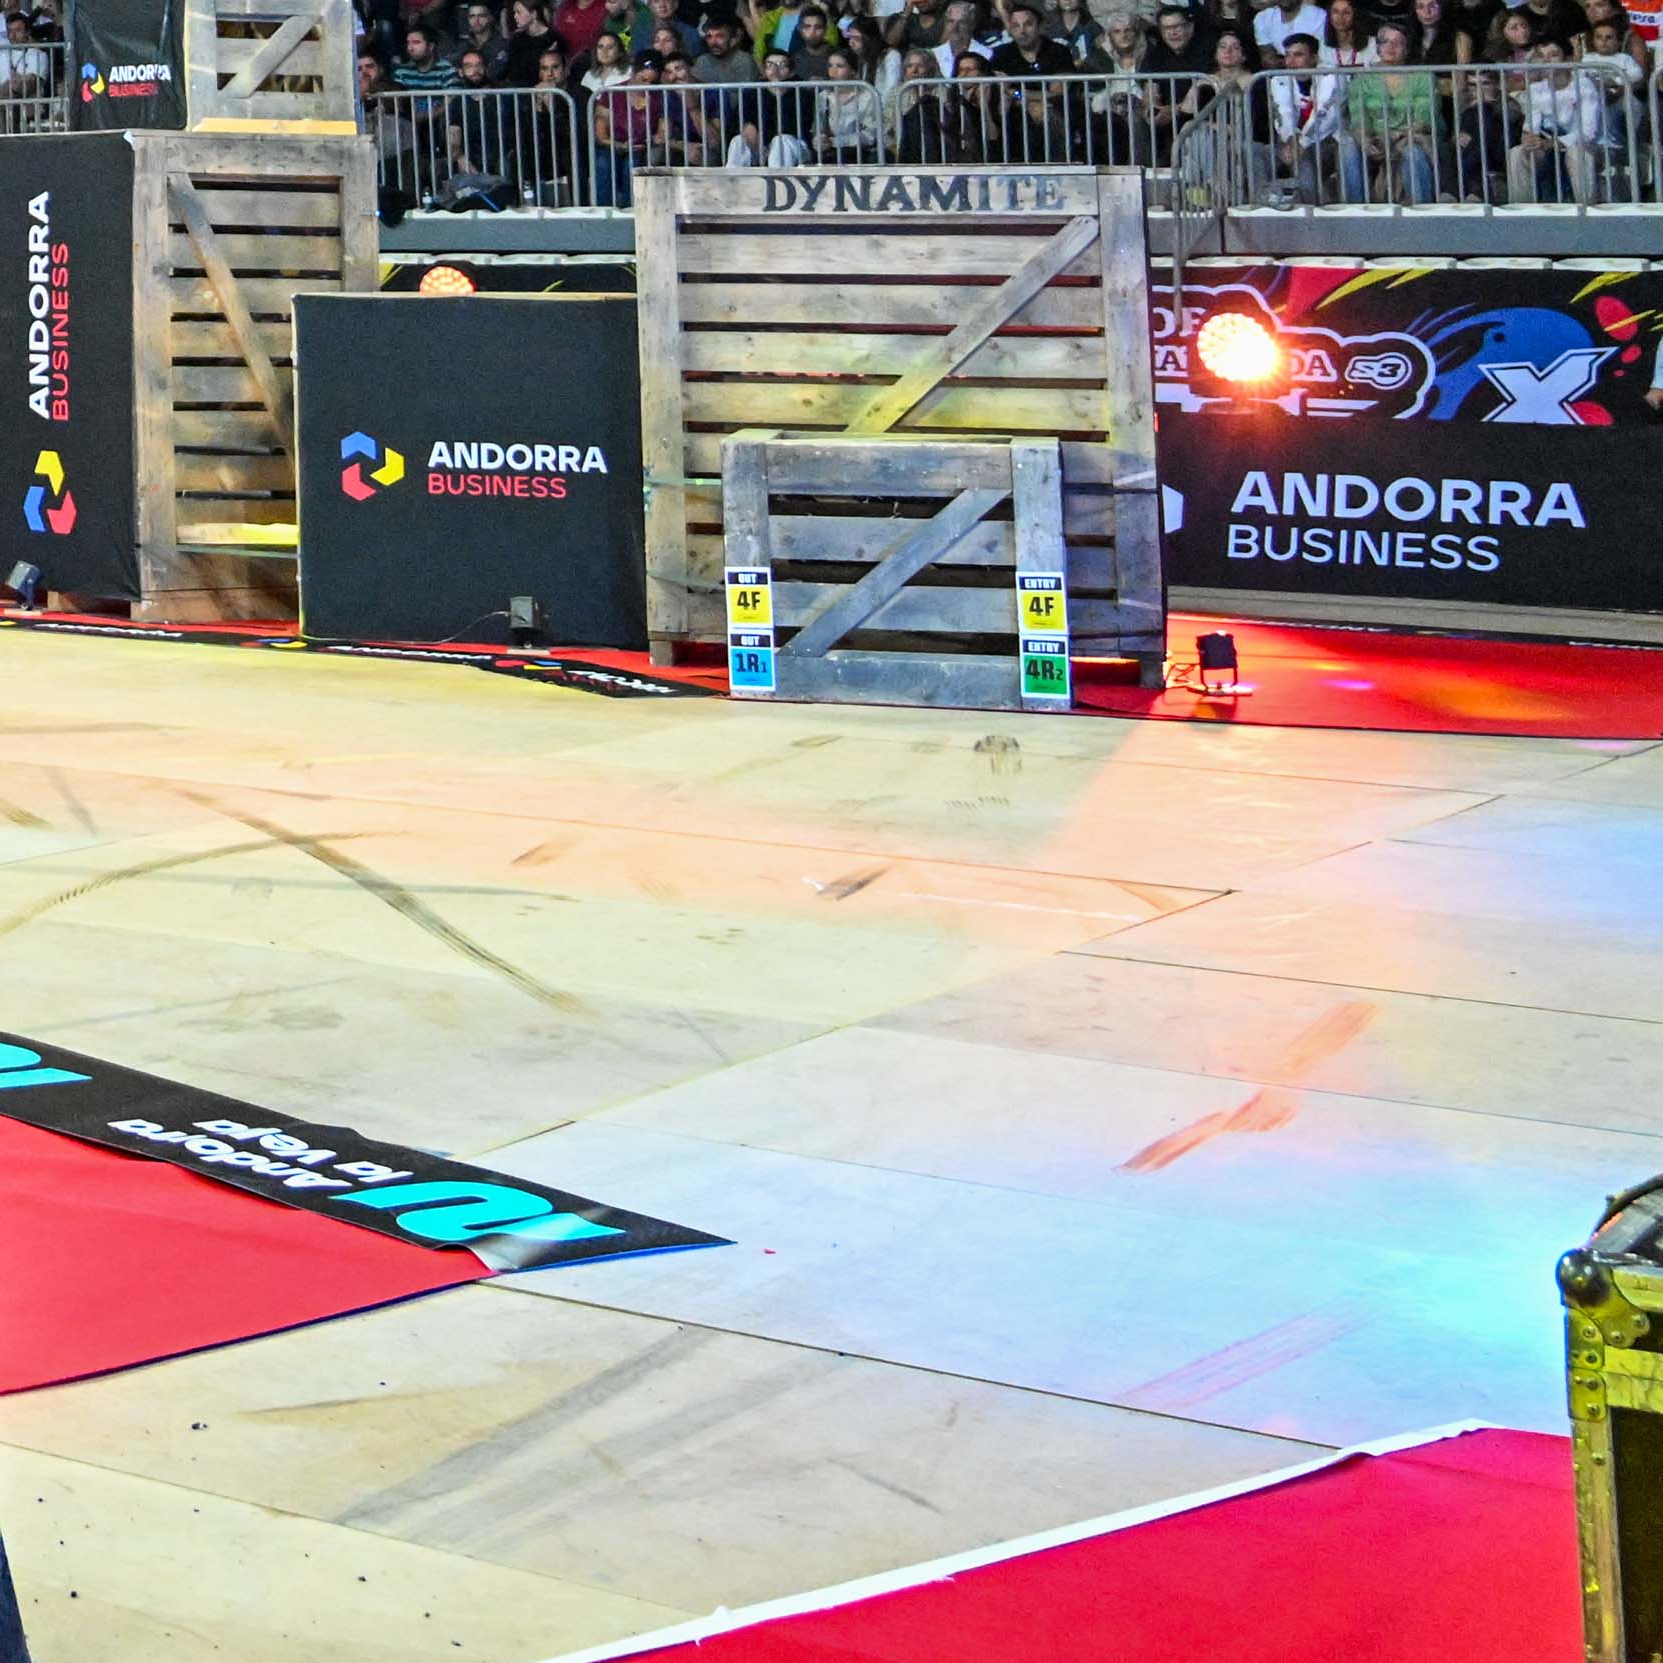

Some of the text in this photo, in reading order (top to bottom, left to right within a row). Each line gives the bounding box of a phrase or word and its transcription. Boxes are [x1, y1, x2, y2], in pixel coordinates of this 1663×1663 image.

[763, 175, 1065, 211] DYNAMITE
[28, 191, 50, 420] ANDORRA
[52, 242, 70, 423] BUSINESS
[428, 440, 607, 474] ANDORRA
[428, 473, 567, 499] BUSINESS
[1230, 470, 1587, 529] ANDORRA
[1227, 524, 1501, 573] BUSINESS
[736, 591, 761, 611] 4F
[1029, 596, 1055, 617] 4F
[107, 1119, 353, 1188] Andorra
